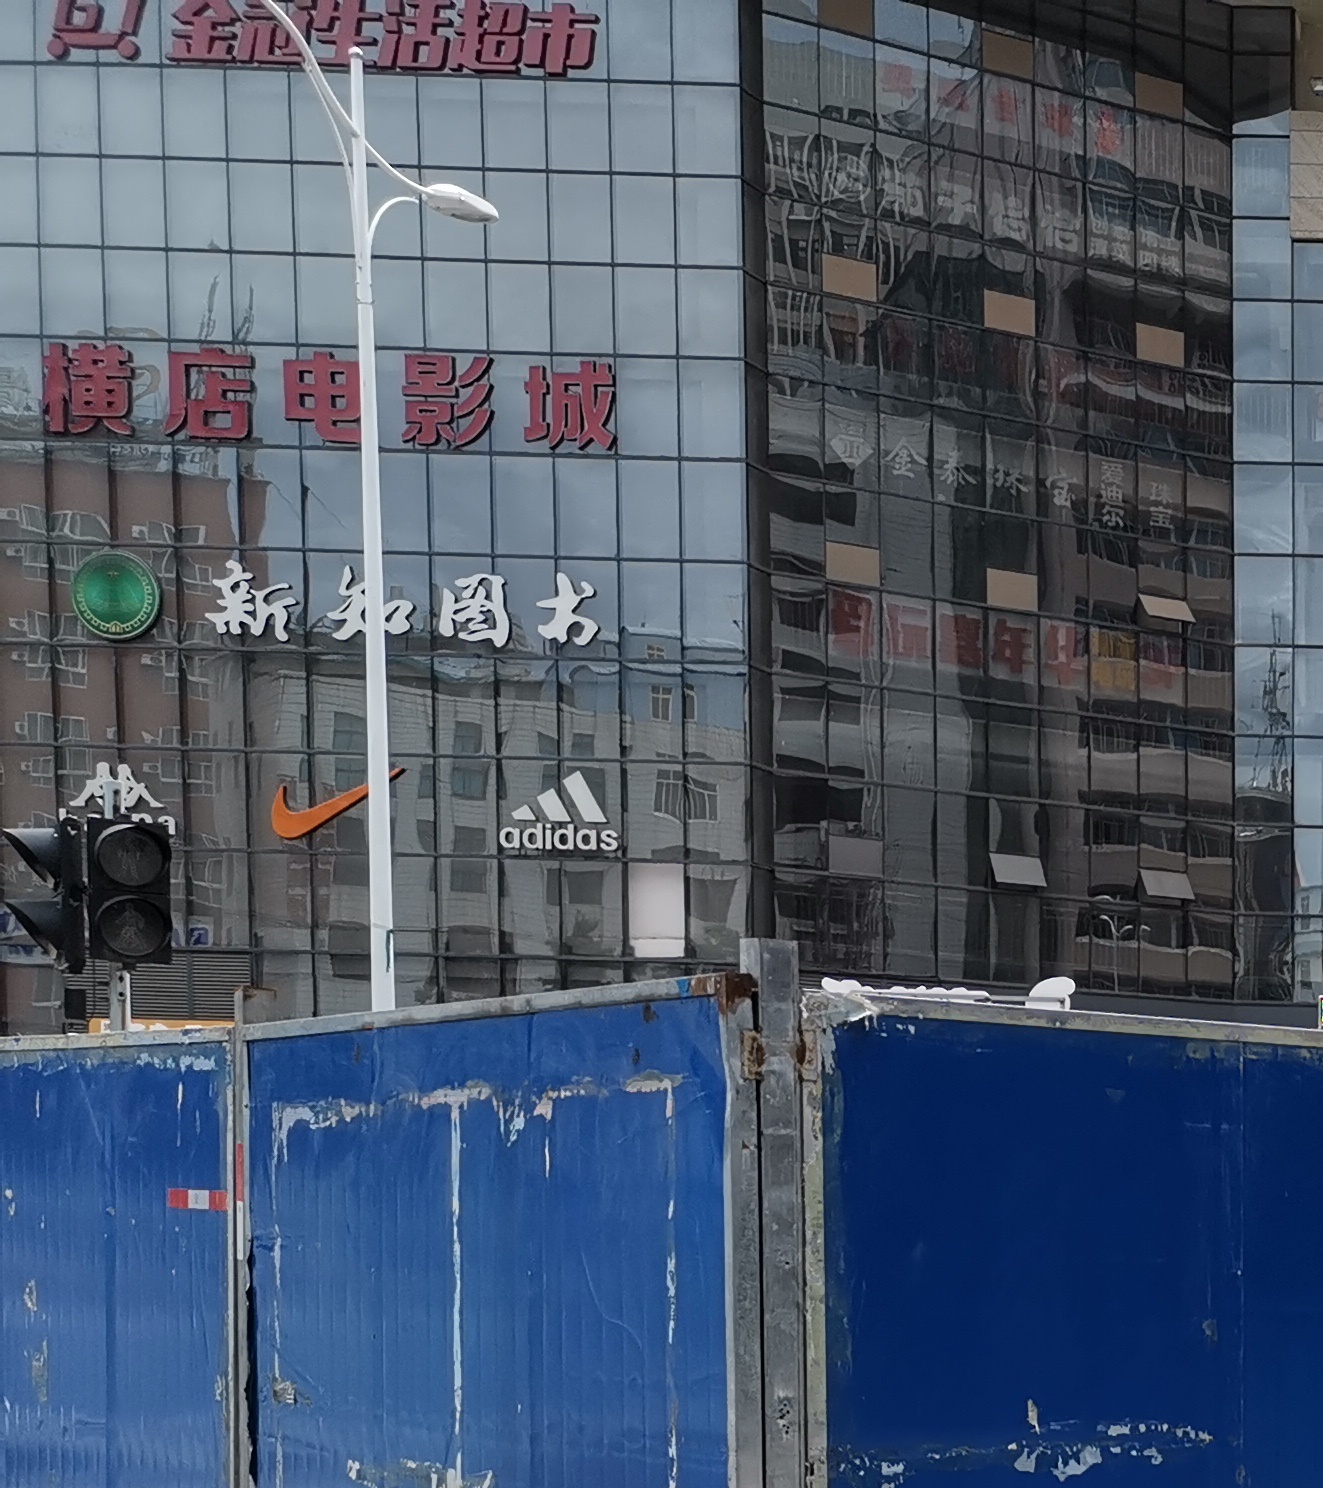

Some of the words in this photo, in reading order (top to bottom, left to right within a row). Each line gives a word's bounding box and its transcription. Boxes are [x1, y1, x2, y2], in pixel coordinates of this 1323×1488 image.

[43, 343, 618, 450] 横店电影城
[1101, 460, 1125, 529] 爱迪尔
[1149, 481, 1174, 529] 珠宝
[205, 558, 600, 648] 新知图书
[499, 824, 619, 852] adidas
